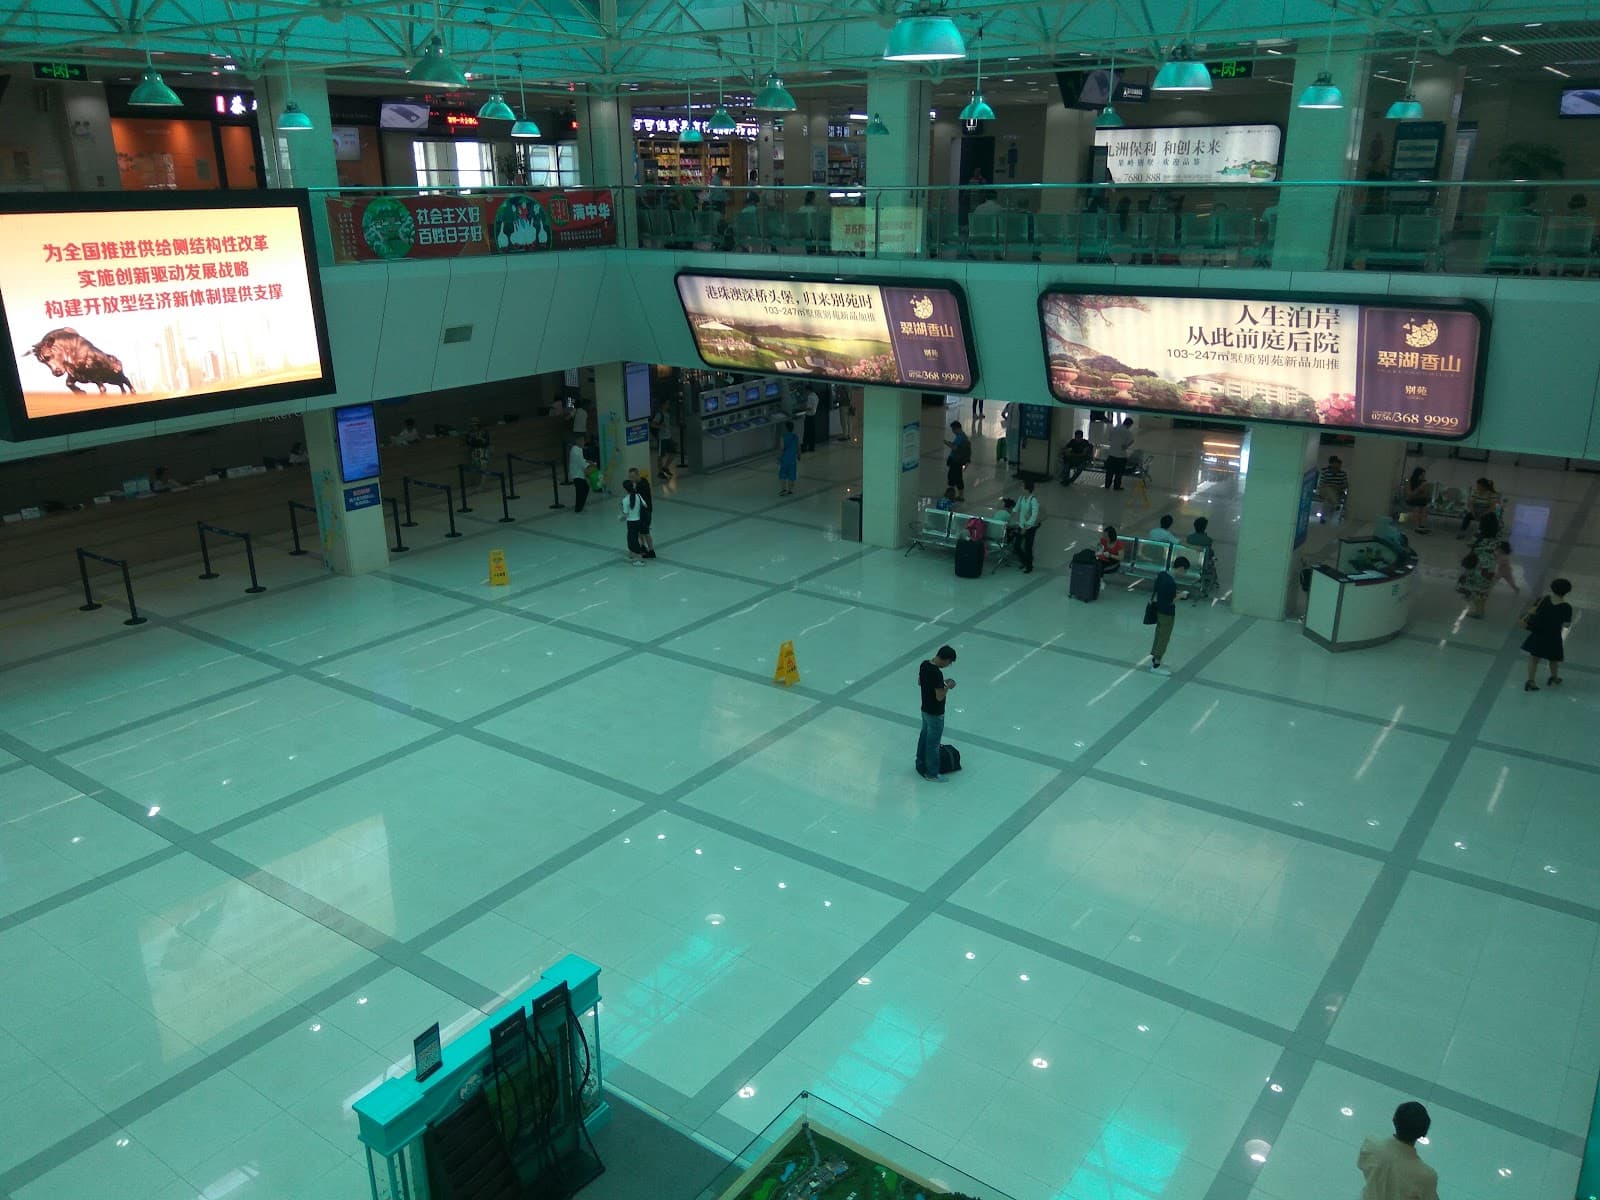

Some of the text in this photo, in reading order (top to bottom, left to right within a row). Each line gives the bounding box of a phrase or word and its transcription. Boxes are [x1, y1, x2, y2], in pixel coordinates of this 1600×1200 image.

[416, 207, 480, 225] 社会主义好
[418, 226, 482, 245] 百姓日子好
[43, 234, 269, 263] 为全国推进供给侧结构性改革
[78, 261, 249, 289] 实施创新驱动发展战略
[44, 283, 283, 319] 构建开放型经济新体制提供支撑
[1235, 304, 1341, 329] 人生泊岸
[900, 321, 954, 338] 翠湖香山
[1186, 326, 1340, 354] 从此前庭后院
[1377, 350, 1461, 372] 翠湖香山
[1424, 414, 1459, 427] 9999
